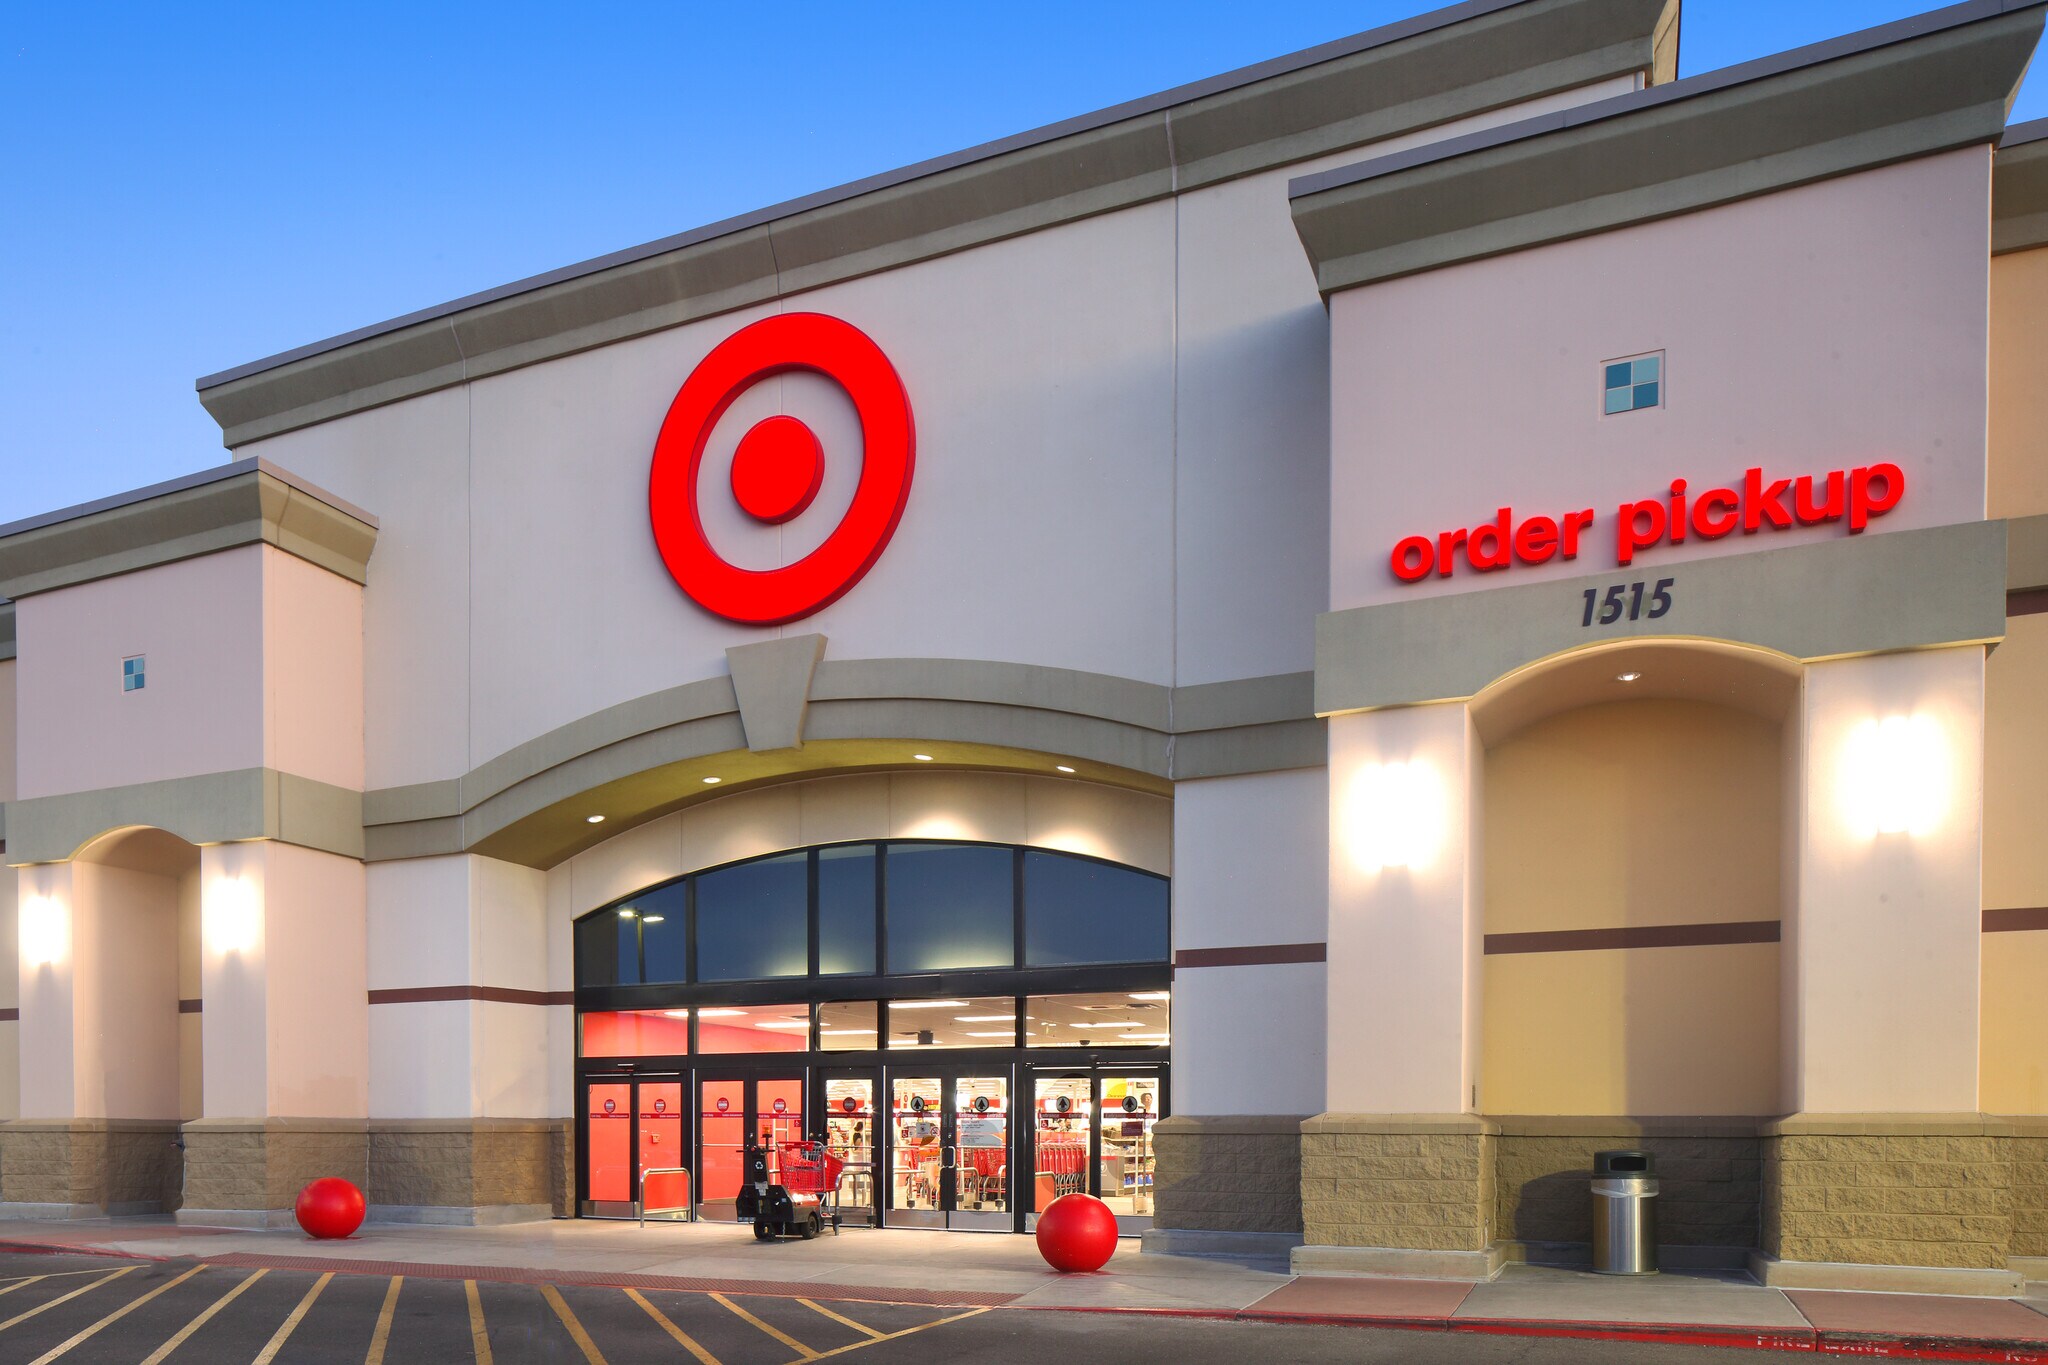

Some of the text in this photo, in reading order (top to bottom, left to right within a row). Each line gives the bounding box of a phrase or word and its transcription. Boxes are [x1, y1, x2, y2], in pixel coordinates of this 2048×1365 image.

[1390, 463, 1905, 583] order pickup
[1581, 578, 1674, 627] 1515
